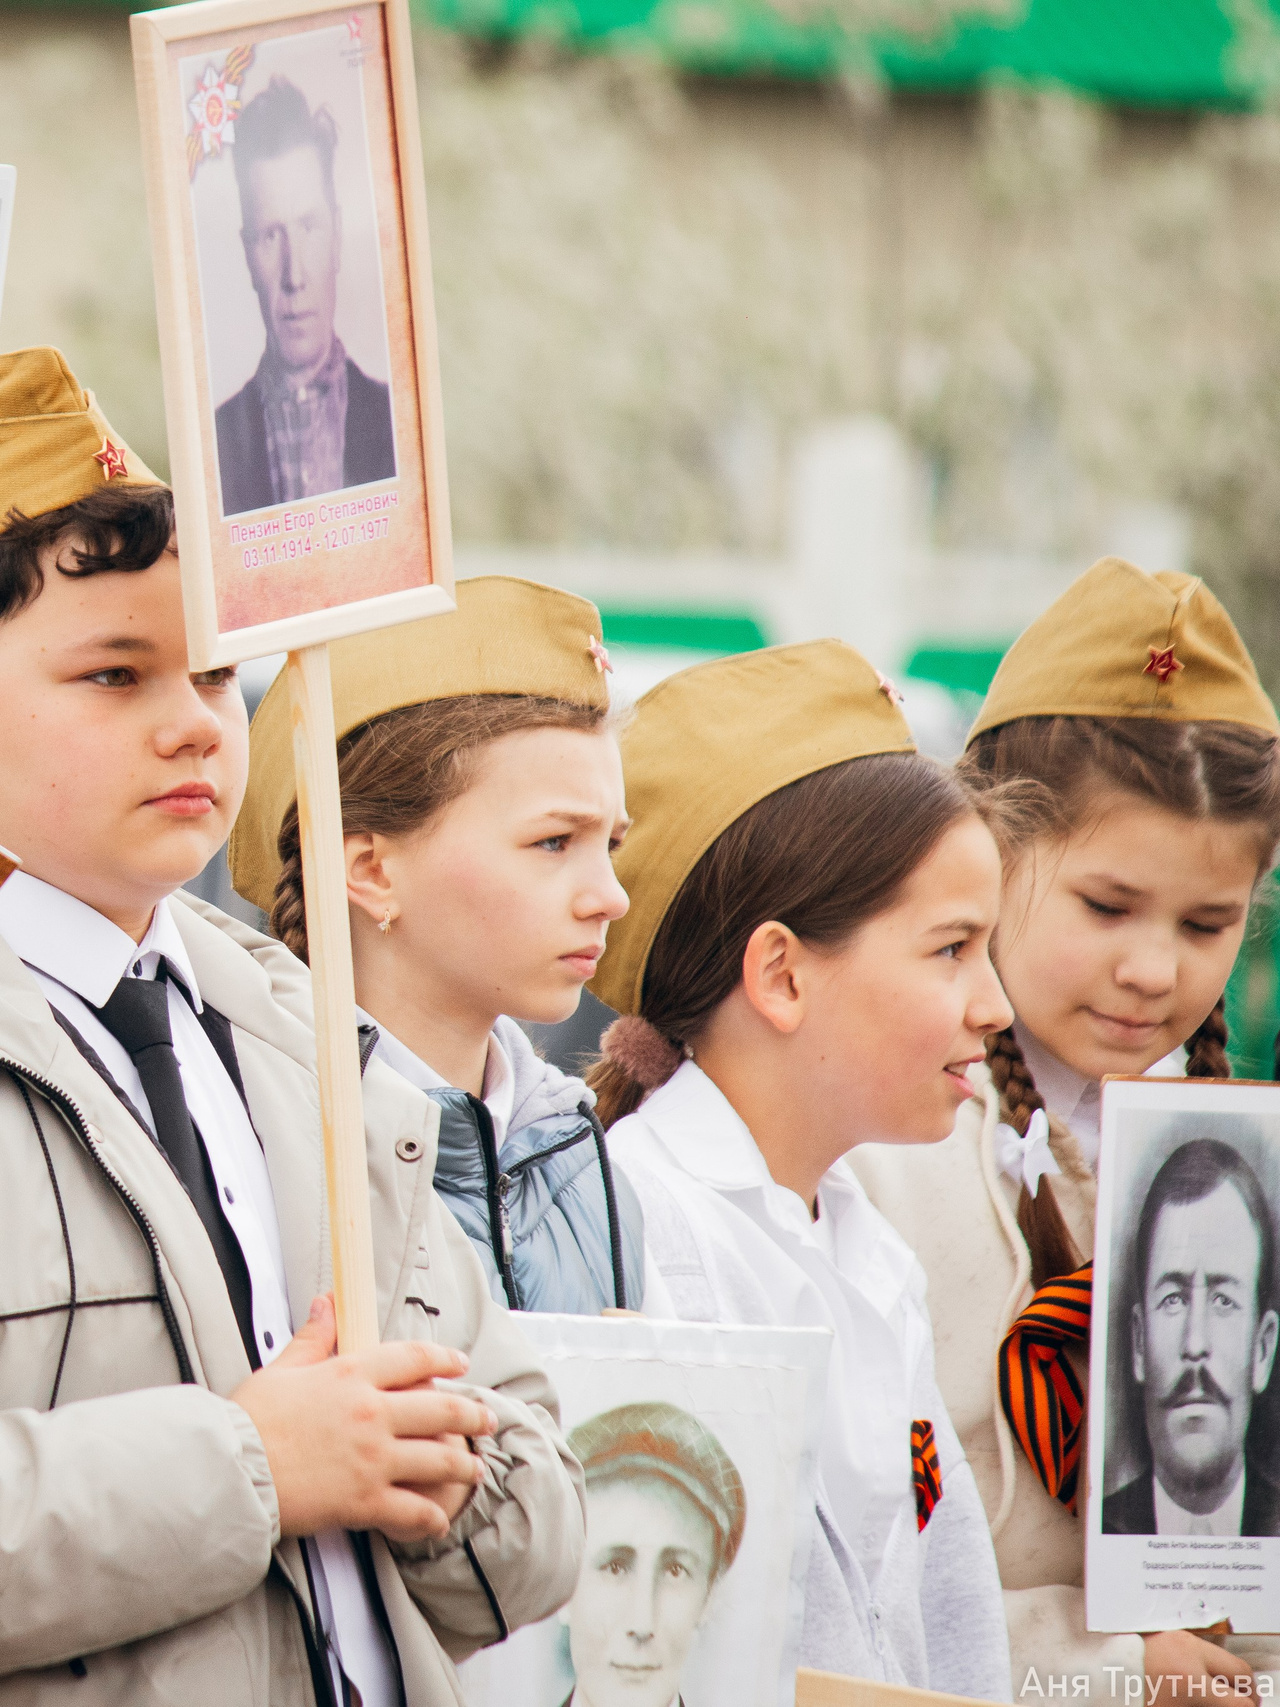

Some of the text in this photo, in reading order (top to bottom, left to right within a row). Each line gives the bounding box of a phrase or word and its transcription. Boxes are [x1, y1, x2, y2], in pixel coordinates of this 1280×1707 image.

[231, 493, 399, 543] Пензин Егор Степанович
[243, 538, 312, 569] 03.11.1914
[324, 517, 389, 550] 12.07.1977
